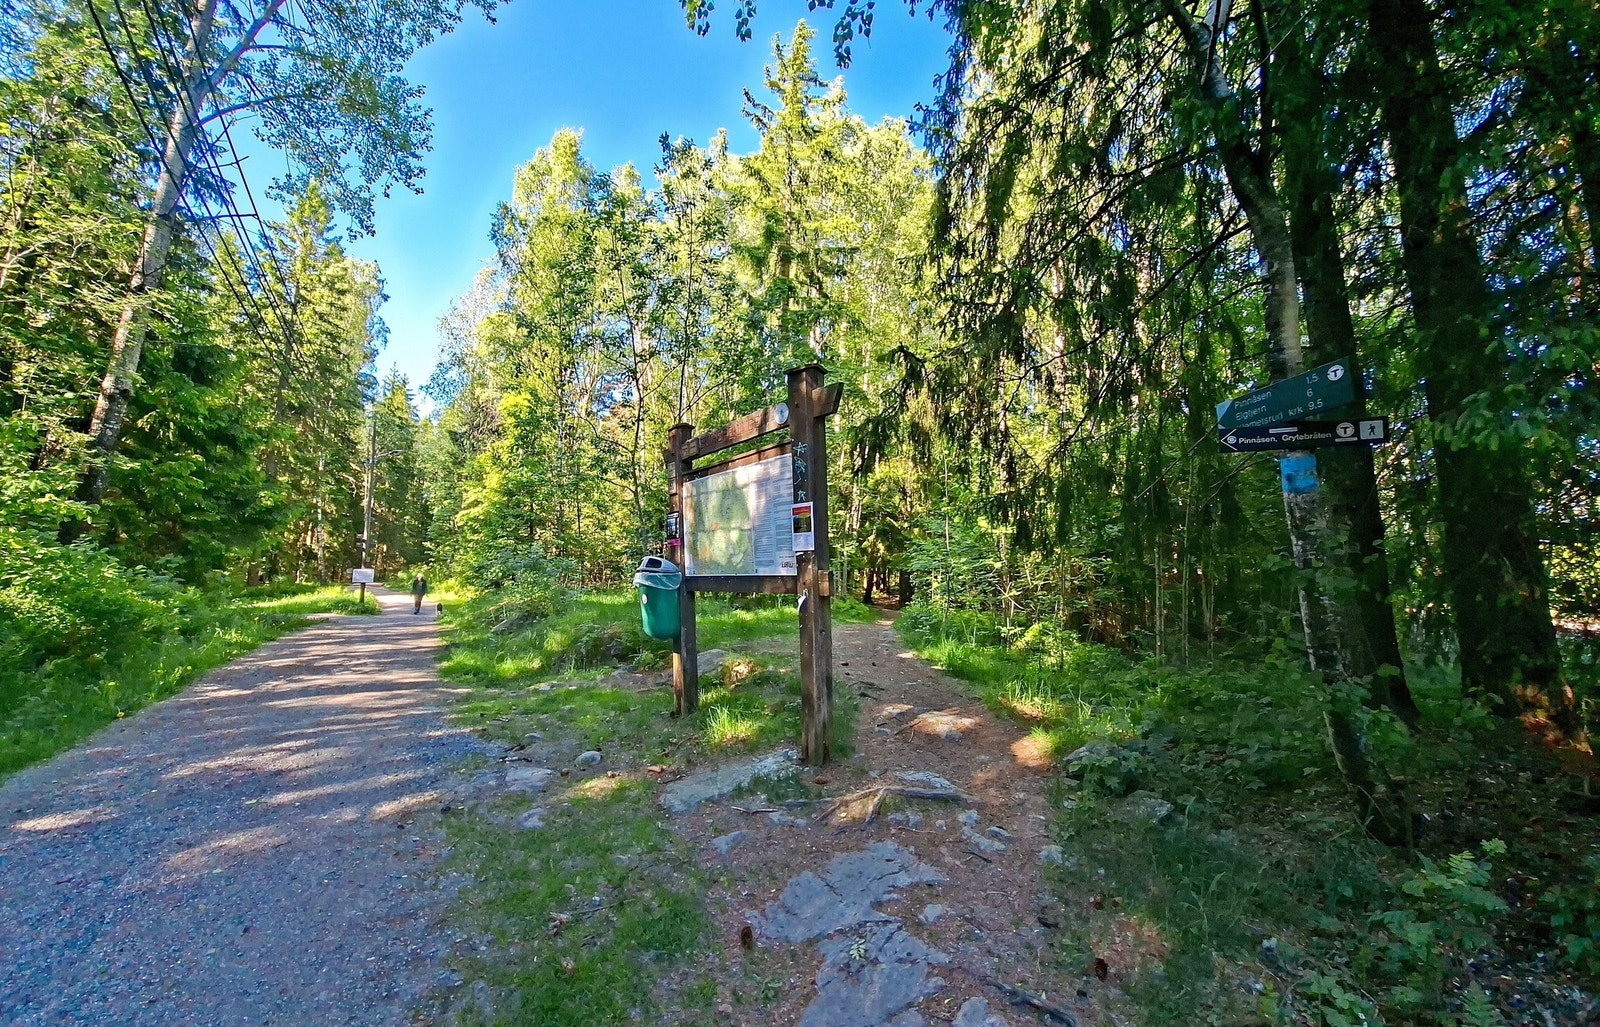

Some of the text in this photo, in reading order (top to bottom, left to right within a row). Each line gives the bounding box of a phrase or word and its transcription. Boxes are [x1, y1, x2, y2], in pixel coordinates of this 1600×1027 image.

[1306, 388, 1314, 398] 6
[1234, 391, 1272, 410] Pinnåsen
[1288, 405, 1304, 417] krk
[1281, 431, 1332, 442] Grytebråten
